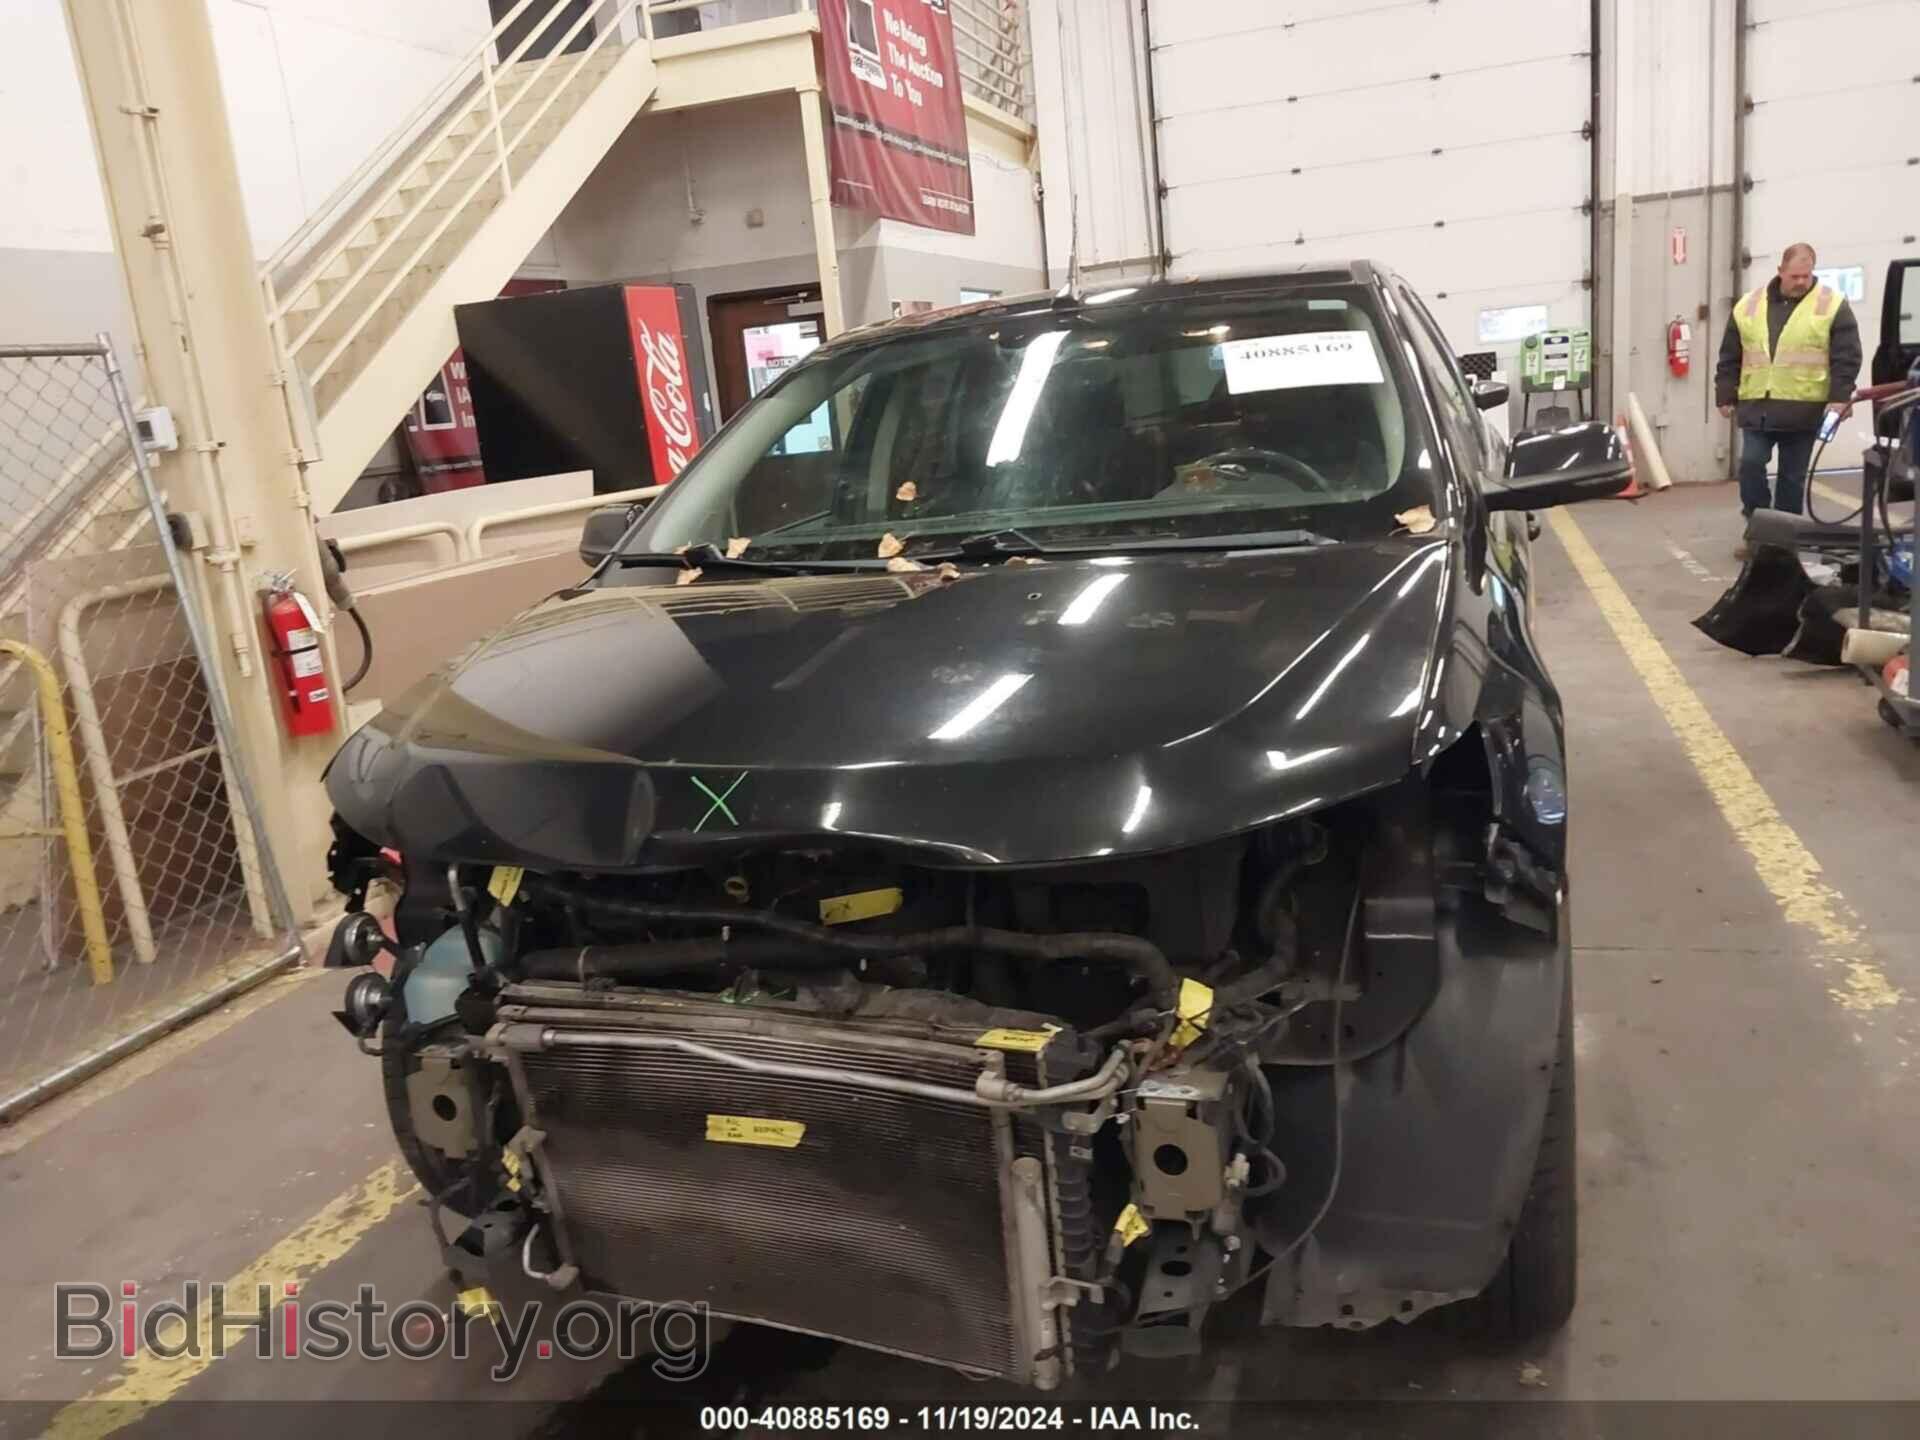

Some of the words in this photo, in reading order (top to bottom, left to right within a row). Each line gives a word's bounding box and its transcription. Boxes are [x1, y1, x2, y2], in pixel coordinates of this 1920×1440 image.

[882, 8, 900, 37] We
[887, 41, 907, 70] The
[891, 73, 904, 98] To
[904, 79, 923, 107] You
